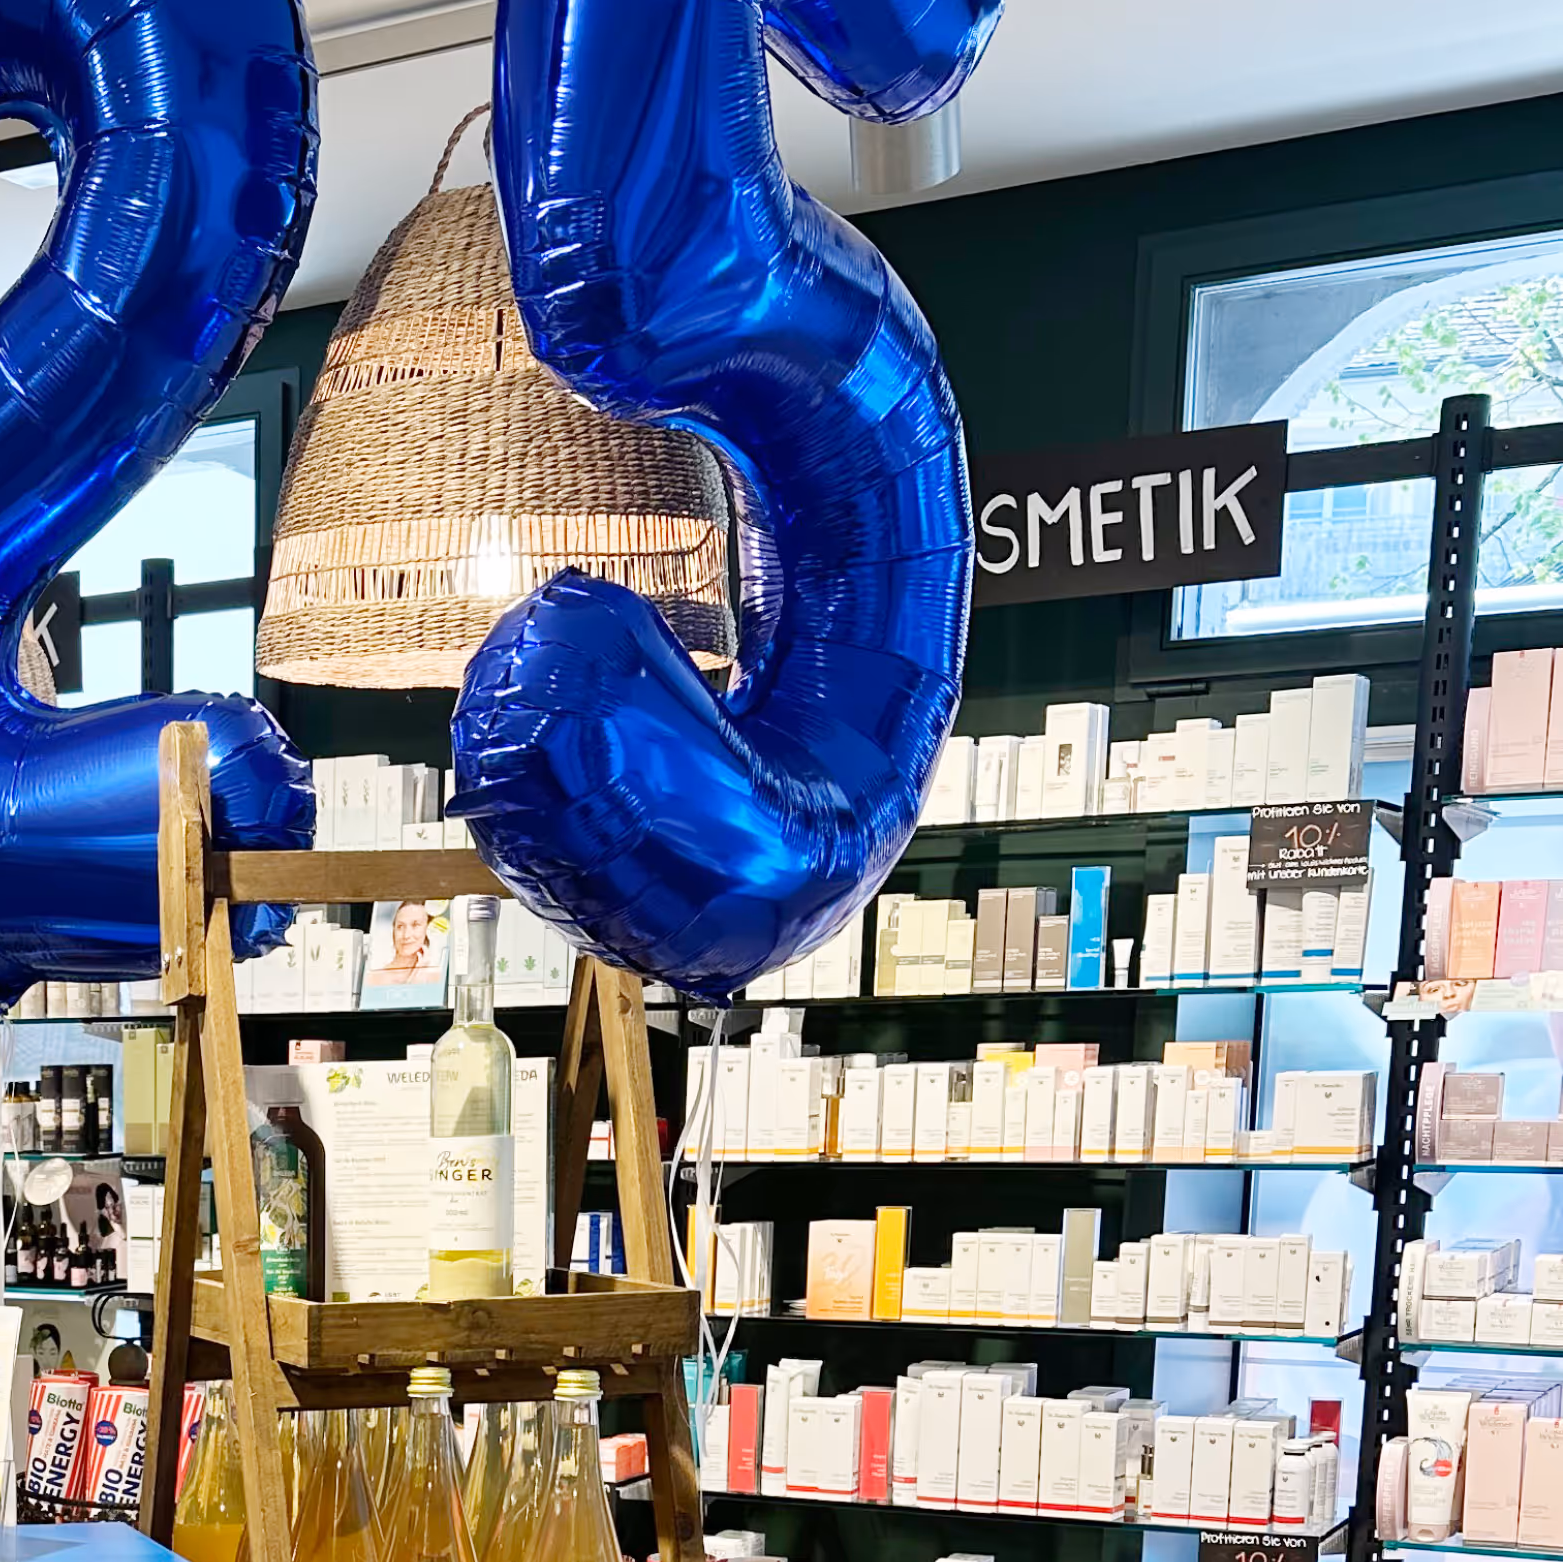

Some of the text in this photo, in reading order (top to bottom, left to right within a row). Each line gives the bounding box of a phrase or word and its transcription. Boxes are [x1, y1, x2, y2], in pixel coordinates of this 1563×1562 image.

[975, 464, 1258, 575] SMETIK
[1312, 803, 1334, 815] Sie
[1336, 802, 1361, 814] von
[1278, 845, 1329, 861] Rabatt
[1247, 870, 1266, 881] mit
[386, 1070, 431, 1084] WELED
[46, 1392, 84, 1412] Biotta
[41, 1411, 81, 1500] ENERGY
[27, 1457, 47, 1495] BIO
[98, 1468, 124, 1506] BIO
[1262, 1535, 1282, 1547] Sie
[1283, 1537, 1307, 1548] von
